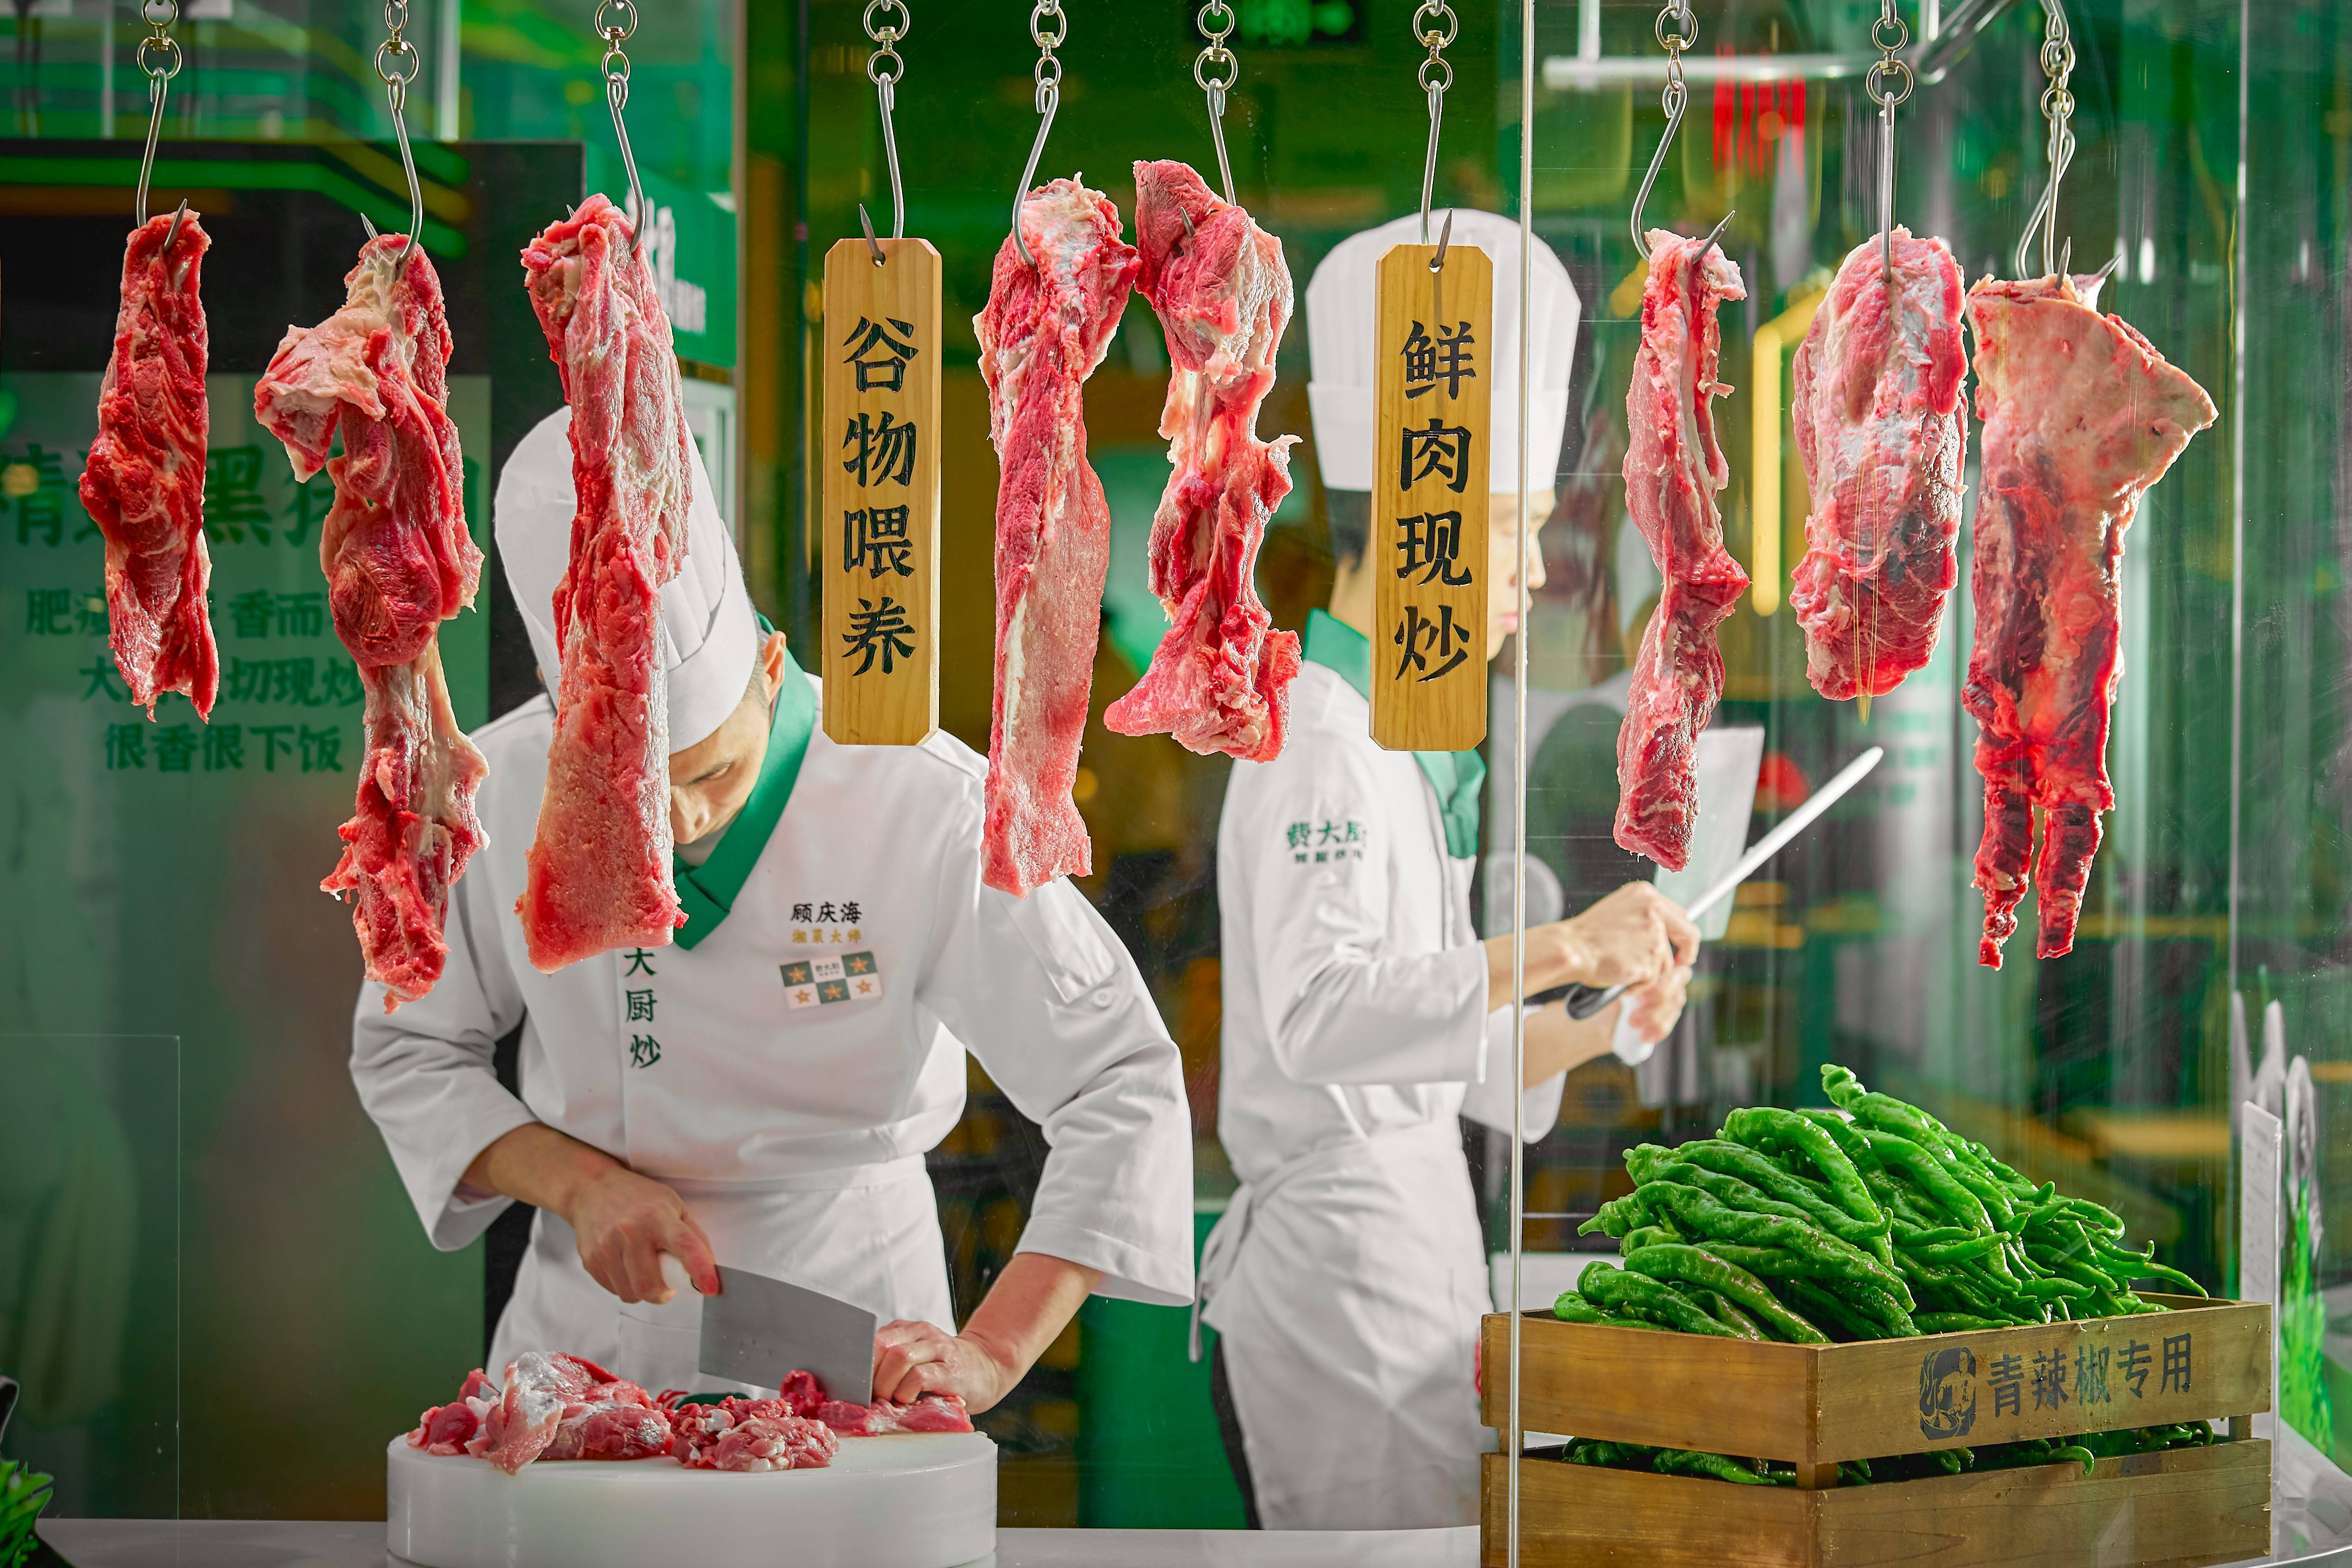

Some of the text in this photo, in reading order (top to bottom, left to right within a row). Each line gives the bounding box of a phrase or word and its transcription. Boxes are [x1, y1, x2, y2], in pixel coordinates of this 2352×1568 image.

[842, 316, 919, 677] 谷物喂养
[1394, 320, 1476, 683] 鲜肉现炒
[80, 655, 365, 707] 大切现炒
[106, 723, 343, 772] 很香很下饭
[790, 901, 862, 924] 顾庆海
[1985, 1332, 2192, 1418] 青辣椒专用
